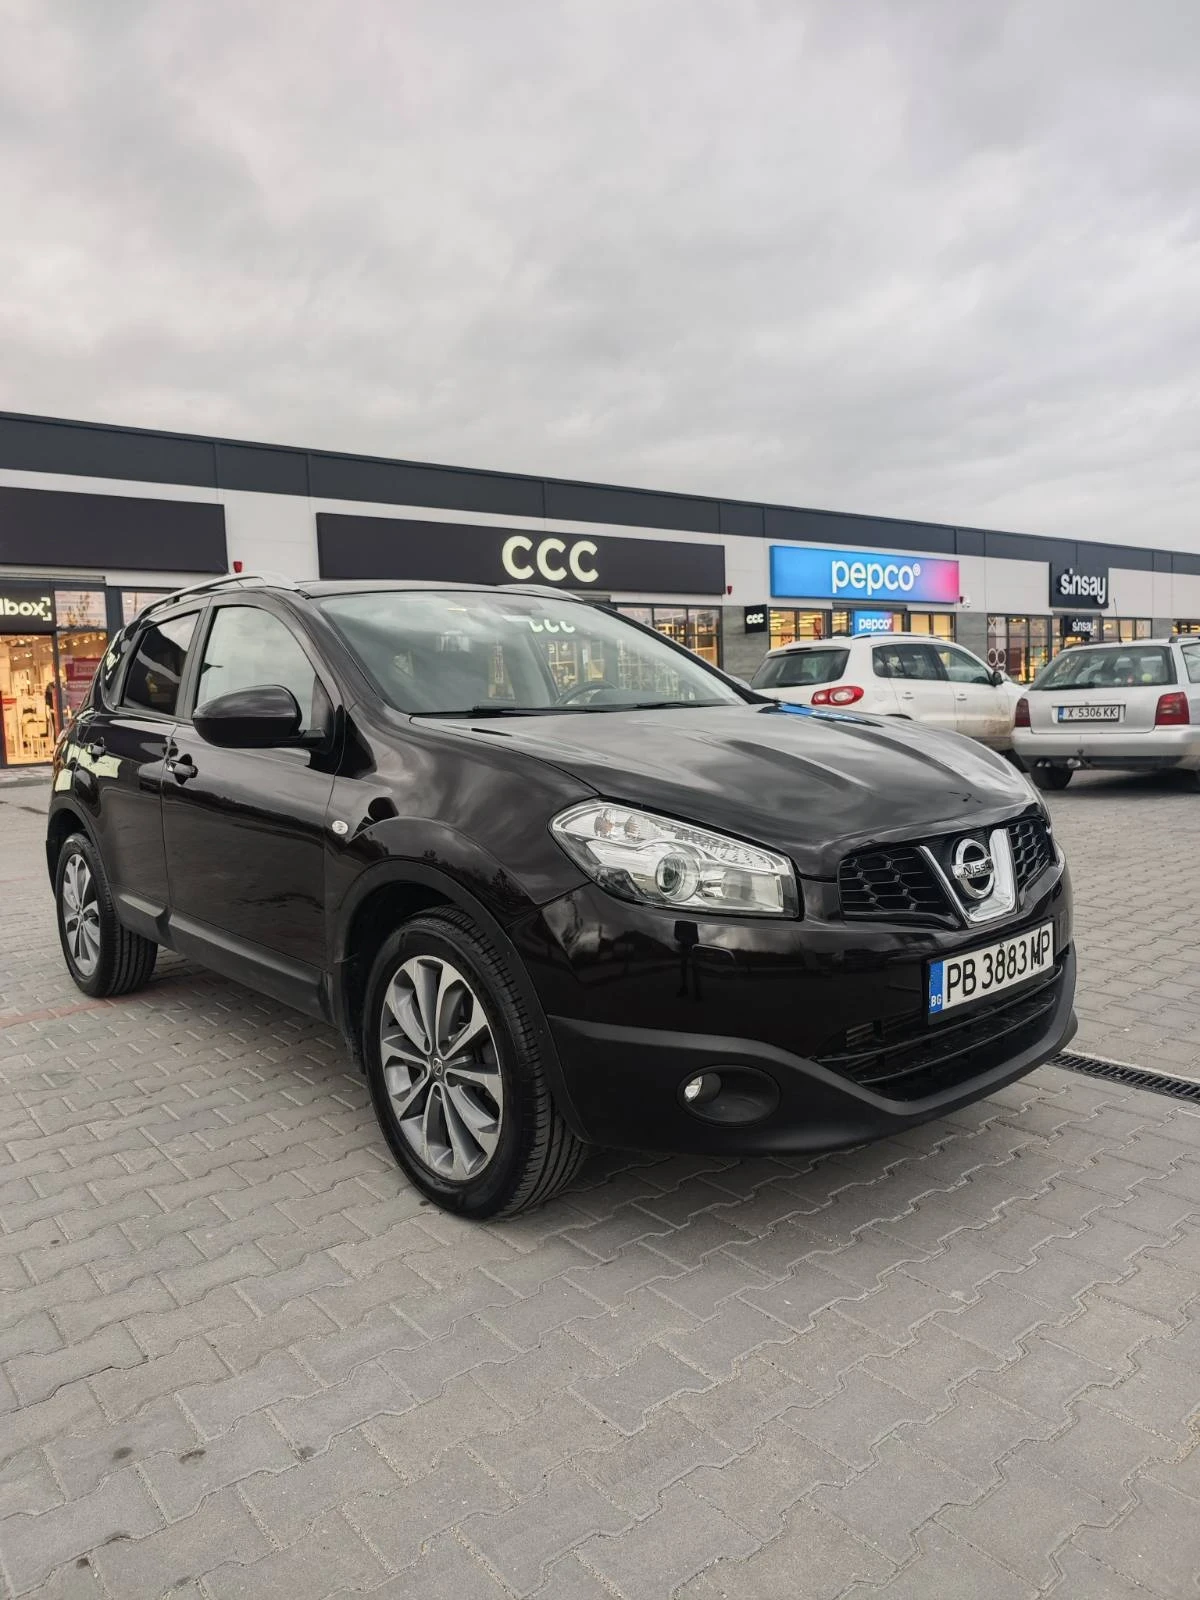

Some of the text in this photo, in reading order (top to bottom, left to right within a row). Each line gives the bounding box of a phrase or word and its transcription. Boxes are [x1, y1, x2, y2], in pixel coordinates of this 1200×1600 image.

[502, 535, 599, 583] CCC
[1060, 567, 1106, 604] sinsay
[1078, 707, 1102, 718] 5306
[1103, 707, 1117, 718] KK
[946, 958, 977, 1003] PB
[981, 940, 1028, 990] 3883
[930, 993, 942, 1007] BG
